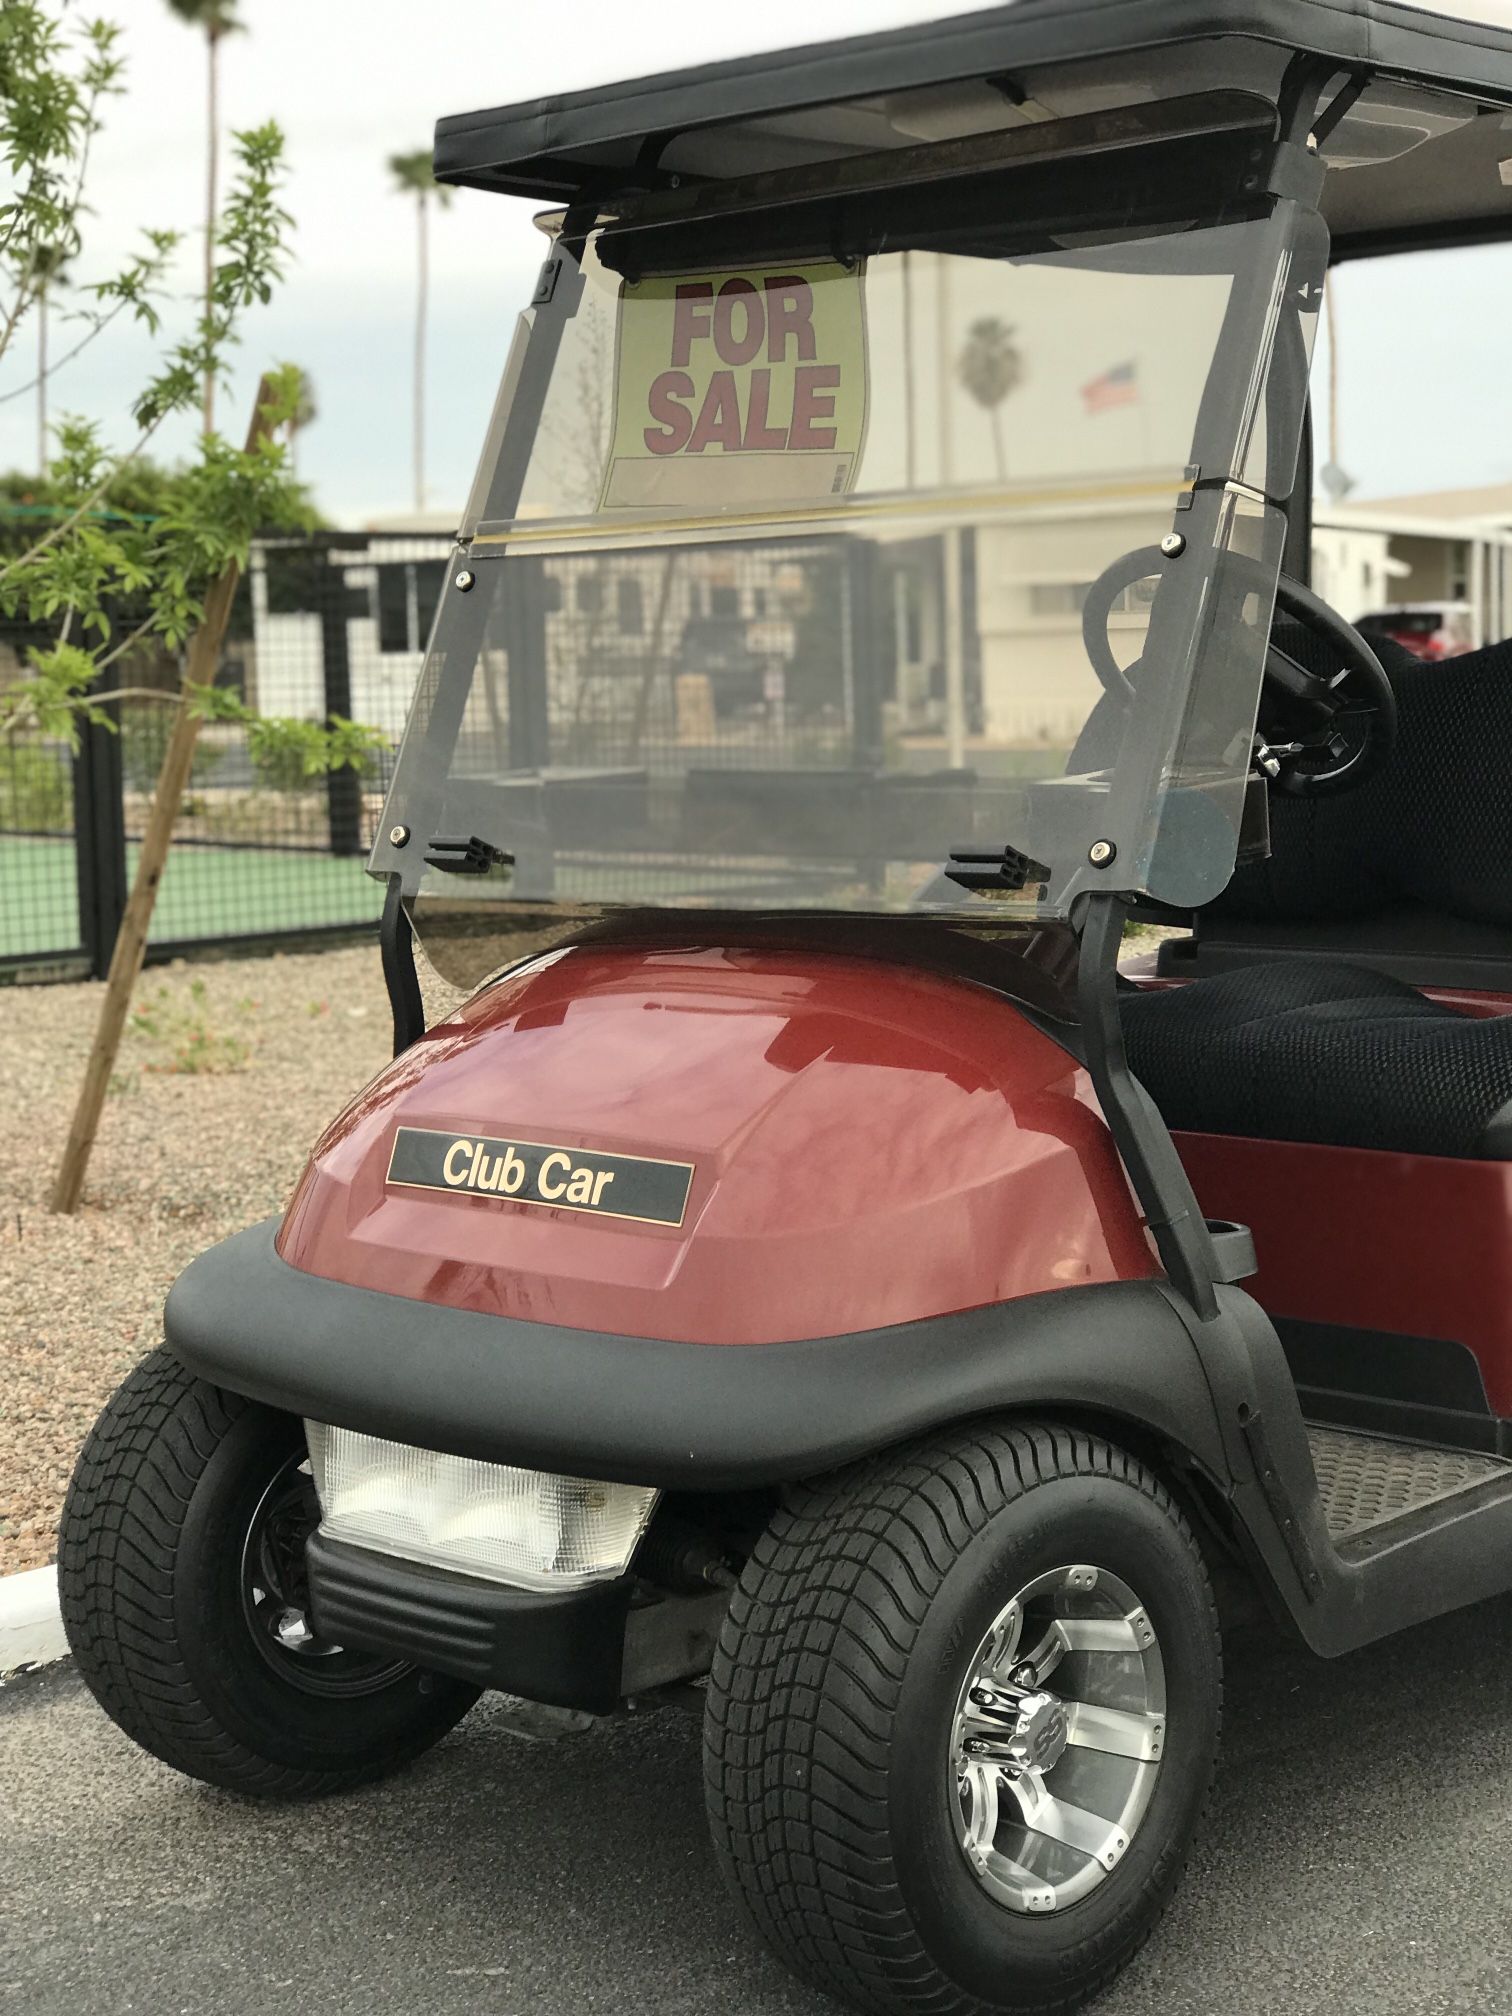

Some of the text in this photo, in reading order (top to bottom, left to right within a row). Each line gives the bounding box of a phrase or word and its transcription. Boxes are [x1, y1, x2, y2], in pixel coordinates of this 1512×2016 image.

[671, 275, 817, 367] FOR
[644, 364, 841, 455] SALE
[443, 1139, 614, 1206] Club Car
